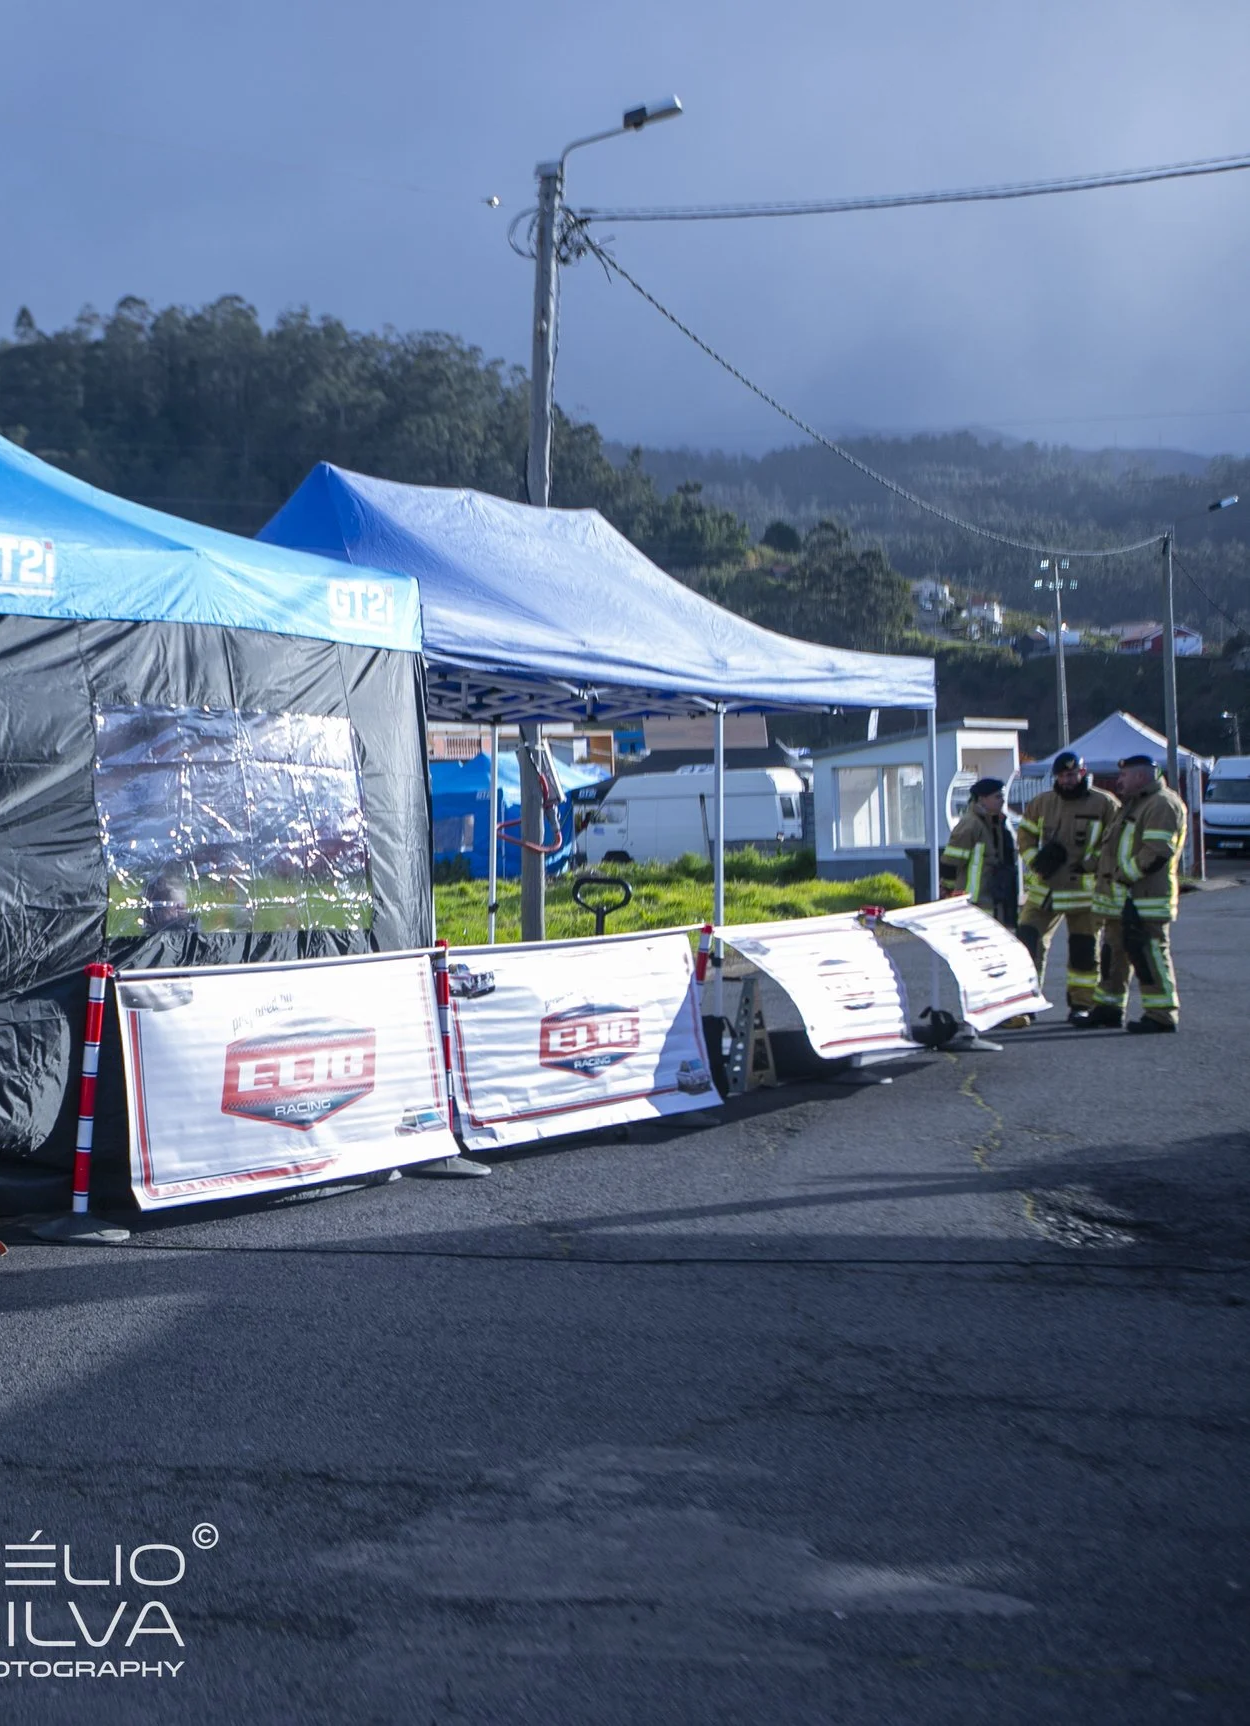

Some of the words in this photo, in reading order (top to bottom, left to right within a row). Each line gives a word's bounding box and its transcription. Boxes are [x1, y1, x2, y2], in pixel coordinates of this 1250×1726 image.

[328, 581, 394, 622] GT2i
[547, 1020, 639, 1053] ELIC
[238, 1047, 366, 1093] ELIC
[573, 1056, 612, 1070] RACING
[274, 1099, 332, 1118] RACING
